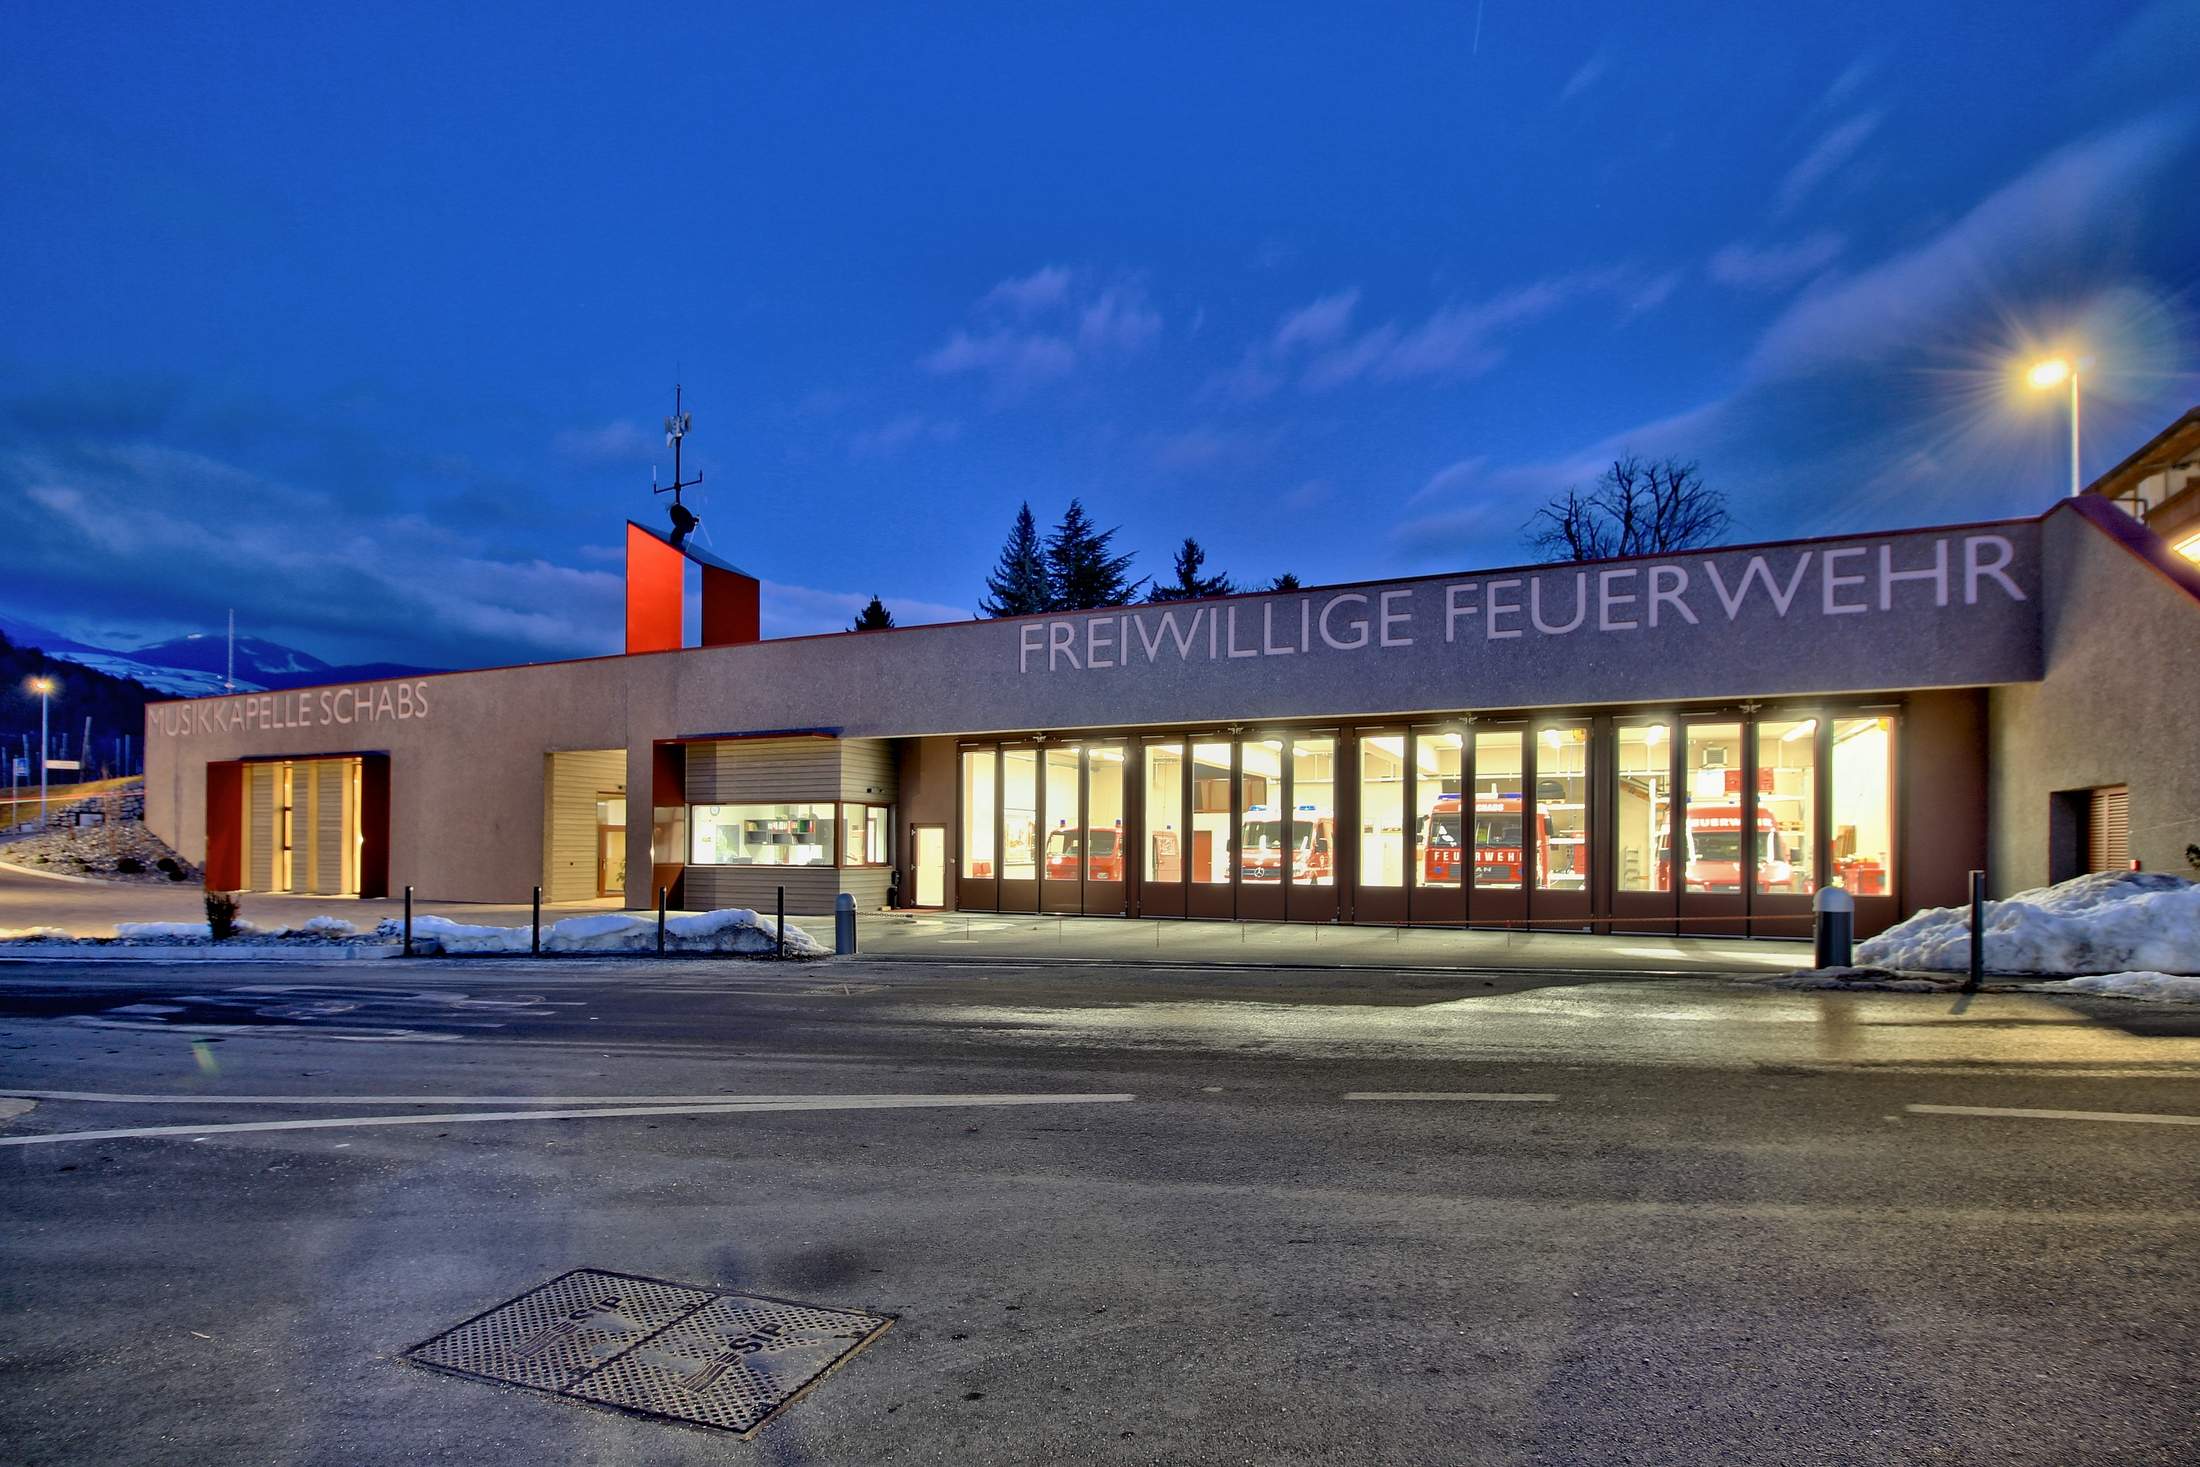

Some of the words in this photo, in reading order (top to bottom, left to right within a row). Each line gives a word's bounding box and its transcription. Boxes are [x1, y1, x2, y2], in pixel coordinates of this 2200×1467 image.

[1019, 589, 1413, 673] FREIWILLIGE
[1445, 535, 2028, 643] FEUERWEHR
[147, 692, 312, 737] MUSIKKAPELLE
[319, 681, 429, 725] SCHABS
[1434, 851, 1522, 862] FEURWEH
[729, 1323, 782, 1354] SIP
